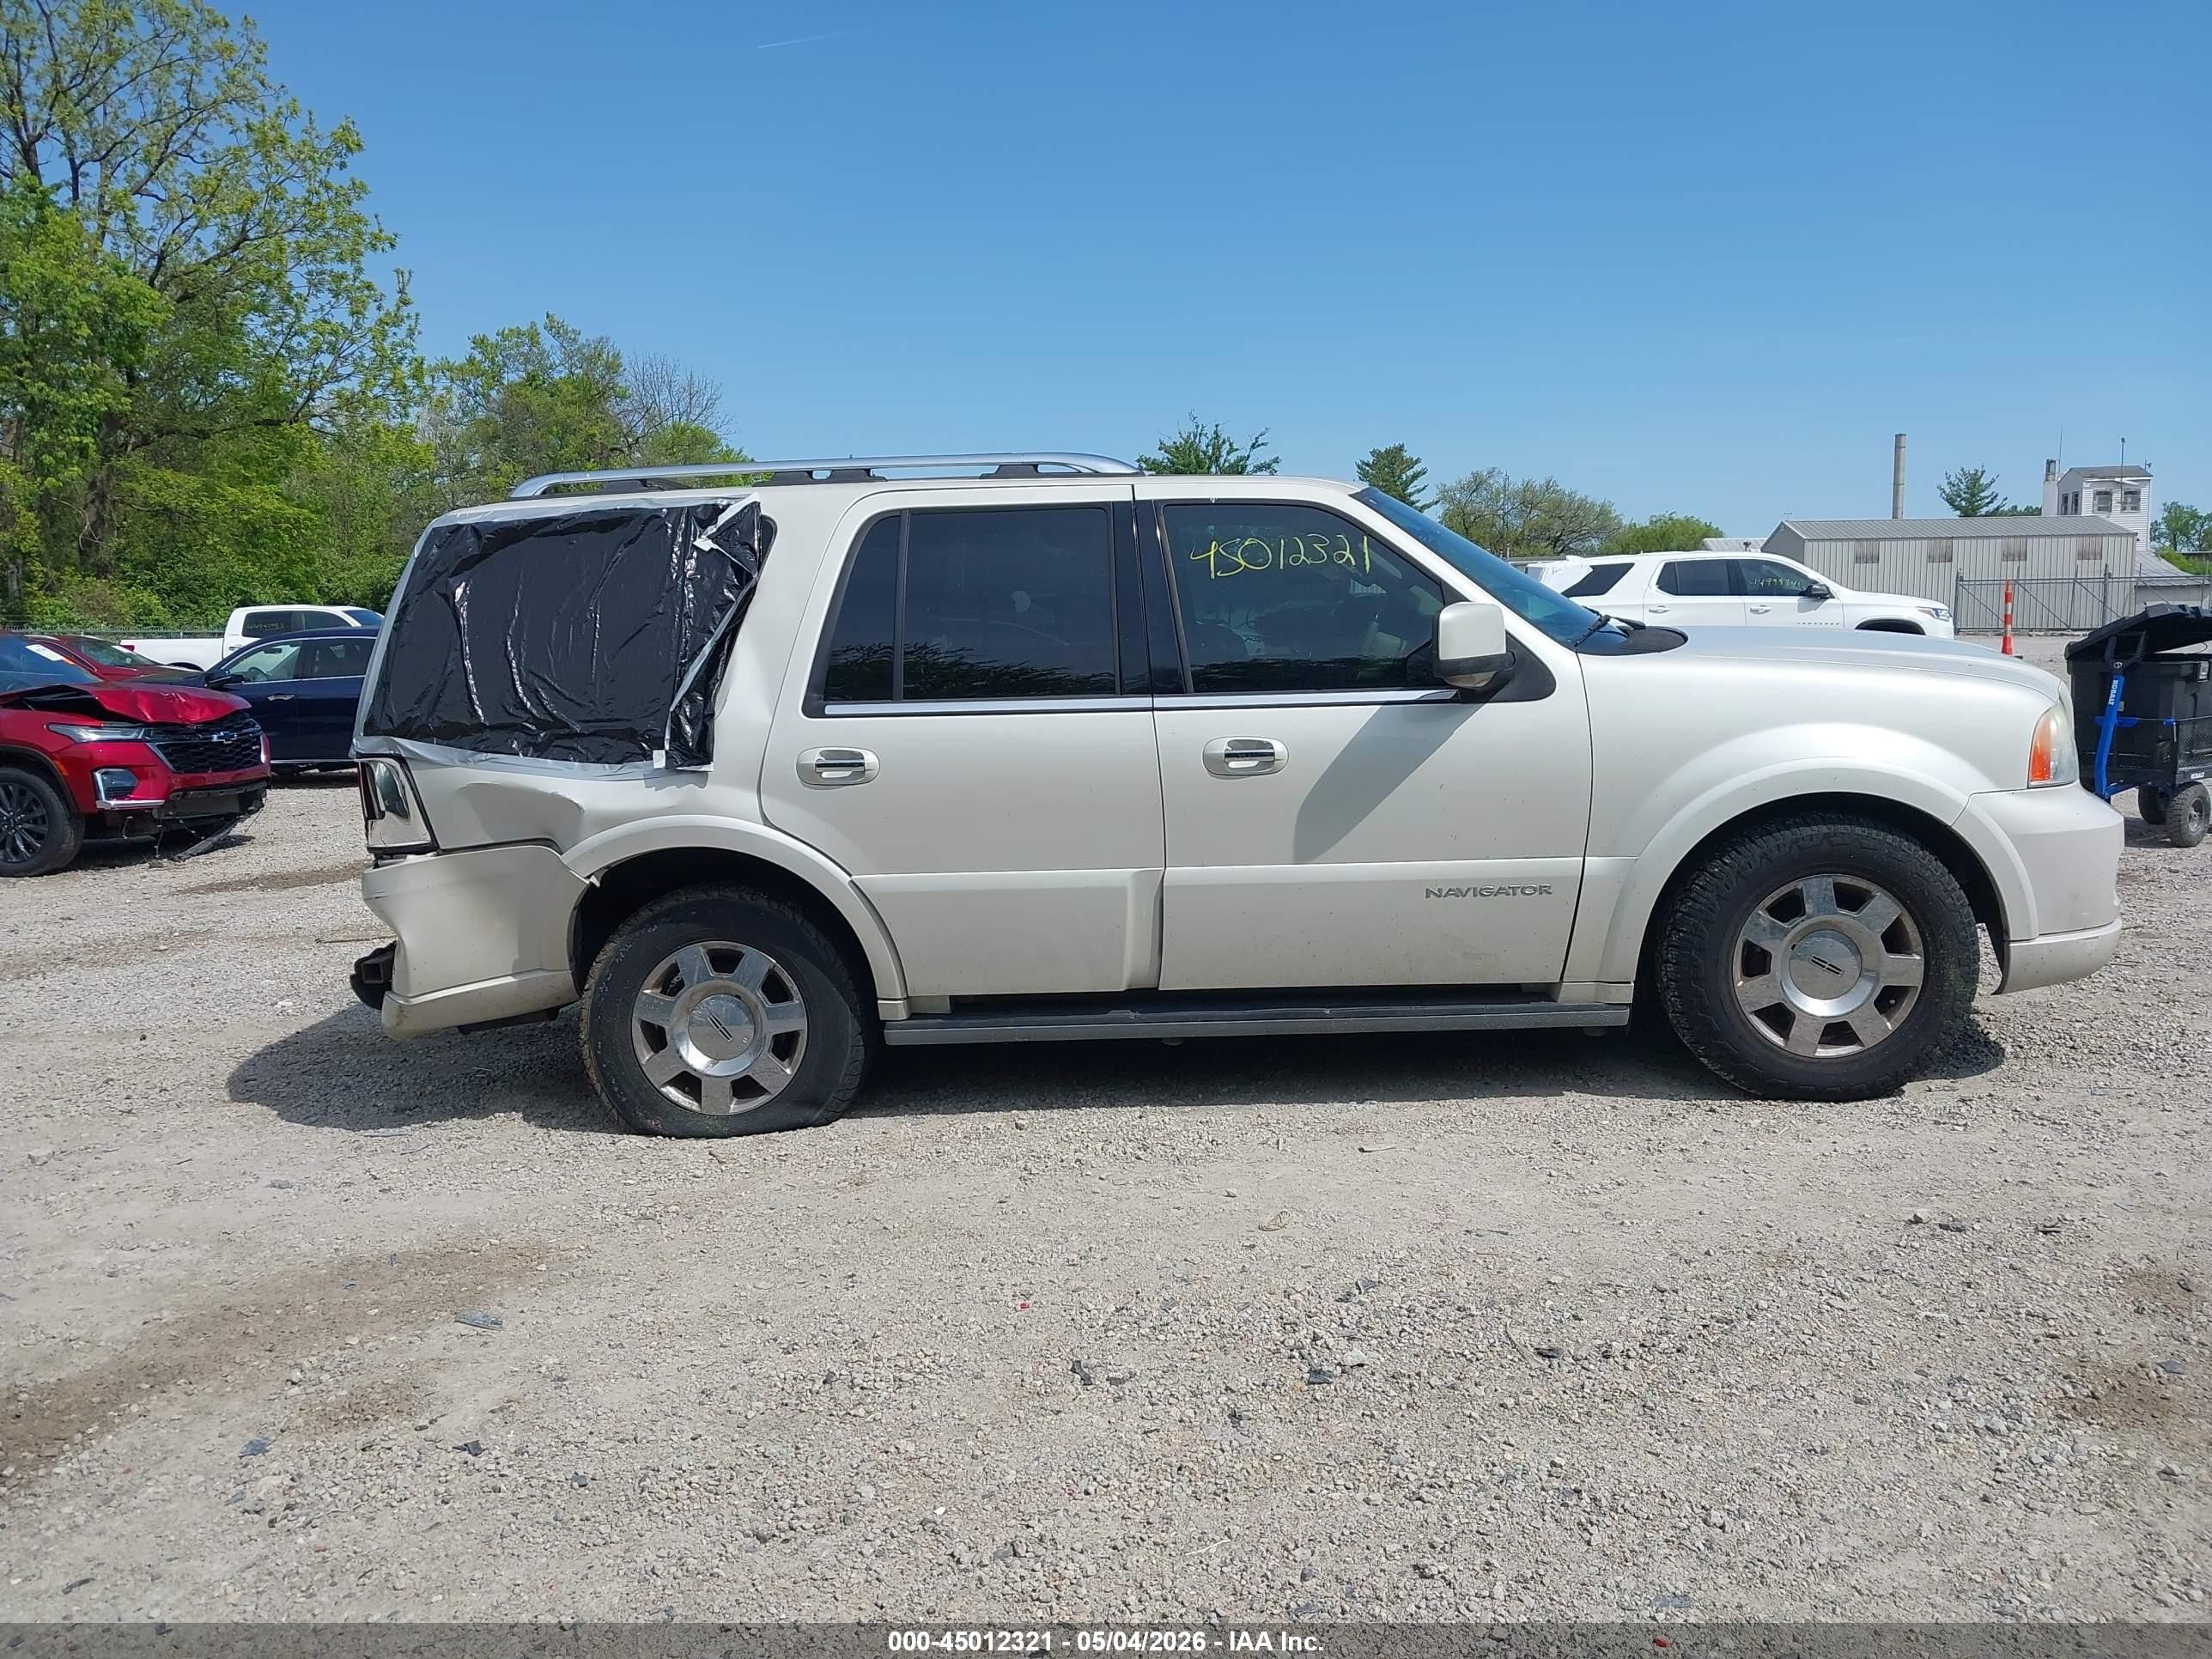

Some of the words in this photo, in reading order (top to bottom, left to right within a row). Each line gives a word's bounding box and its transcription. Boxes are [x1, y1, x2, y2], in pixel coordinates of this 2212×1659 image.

[1190, 534, 1370, 580] 45012321
[2107, 679, 2119, 706] KOBALT
[1425, 884, 1553, 899] NAVIGATOR
